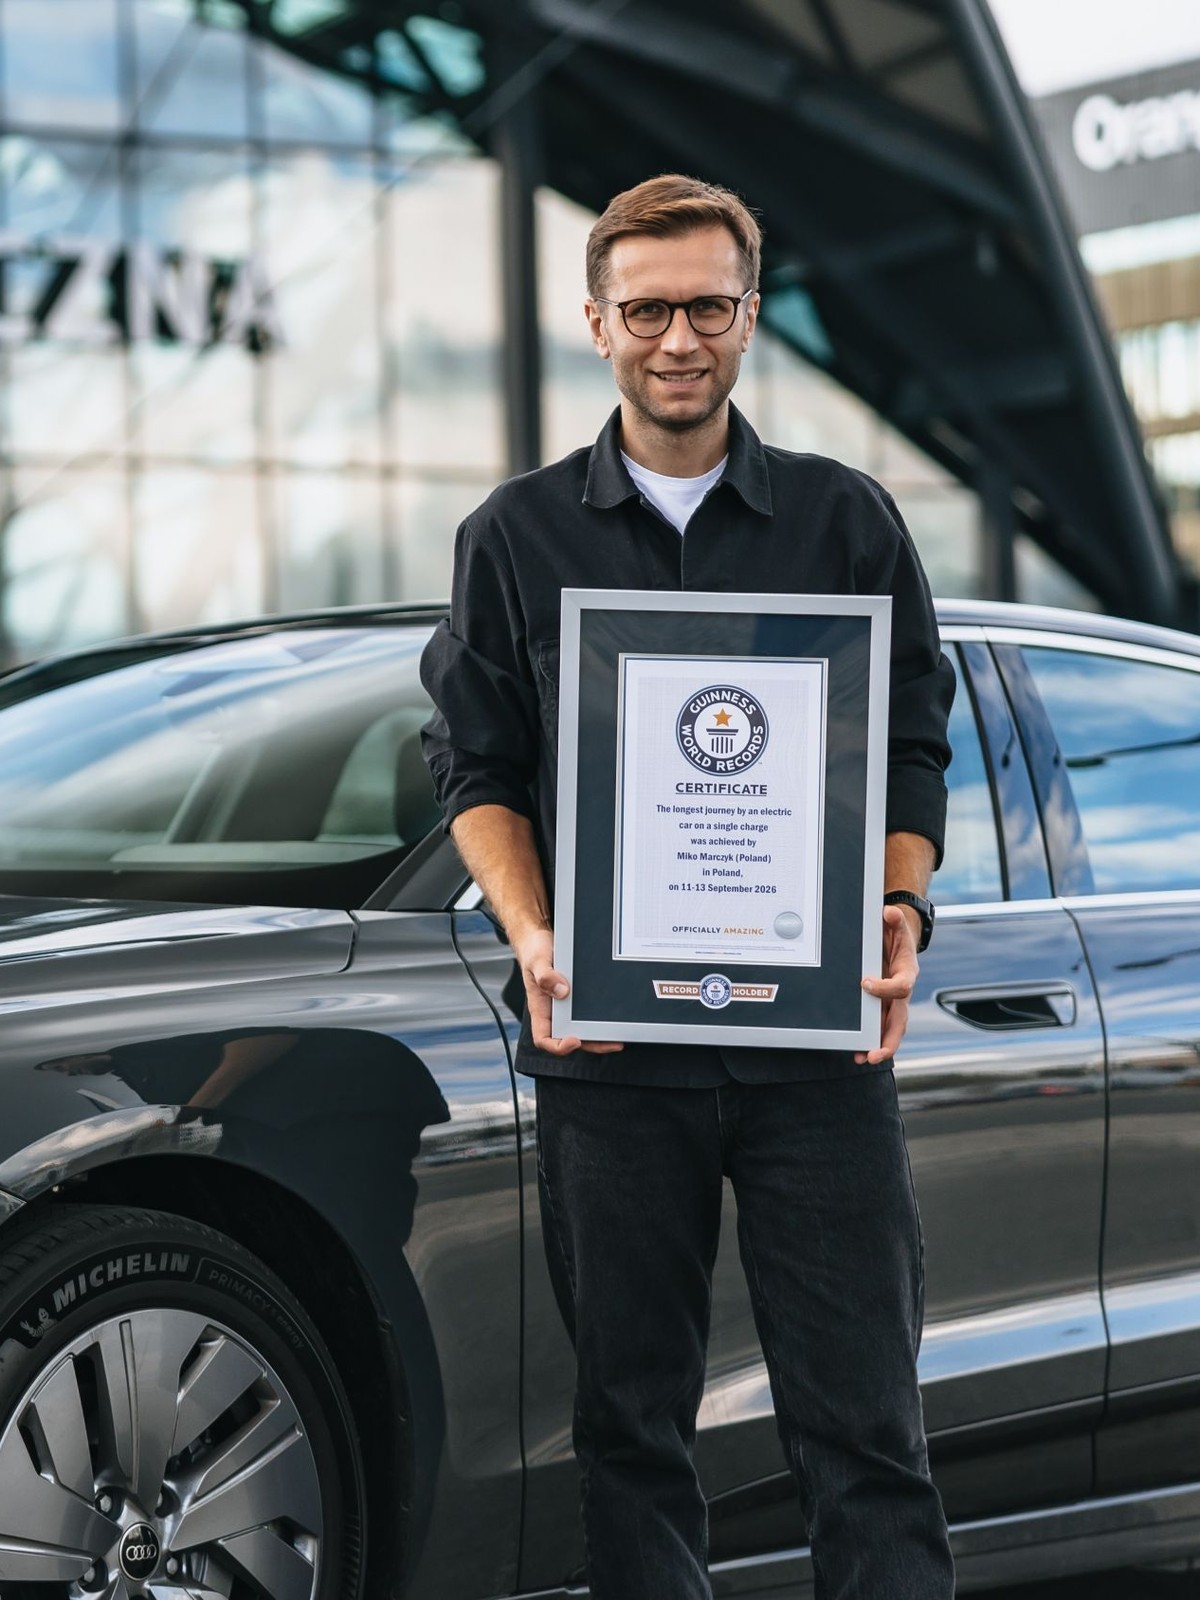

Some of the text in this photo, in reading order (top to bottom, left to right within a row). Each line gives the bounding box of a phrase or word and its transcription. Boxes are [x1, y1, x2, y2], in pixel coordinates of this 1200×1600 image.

[689, 690, 757, 715] GUINNESS
[681, 724, 764, 771] WORLD RECORDS
[675, 782, 768, 795] CERTIFICATE
[656, 804, 792, 817] The longest journey by an electric
[678, 822, 693, 830] car
[694, 822, 705, 830] on
[713, 822, 739, 832] single
[740, 822, 769, 833] charge
[690, 837, 757, 848] was achieved by
[677, 852, 772, 864] Miko Marczyk (Poland)
[702, 868, 744, 878] in Poland,
[681, 883, 706, 892] 11-13
[707, 883, 753, 894] September
[754, 885, 777, 894] 2026
[672, 925, 764, 935] OFFICIALLY AMAZING
[662, 985, 769, 997] RECORD HOLDER
[52, 1252, 190, 1313] MICHELIN
[208, 1269, 271, 1311] PRIMACY
